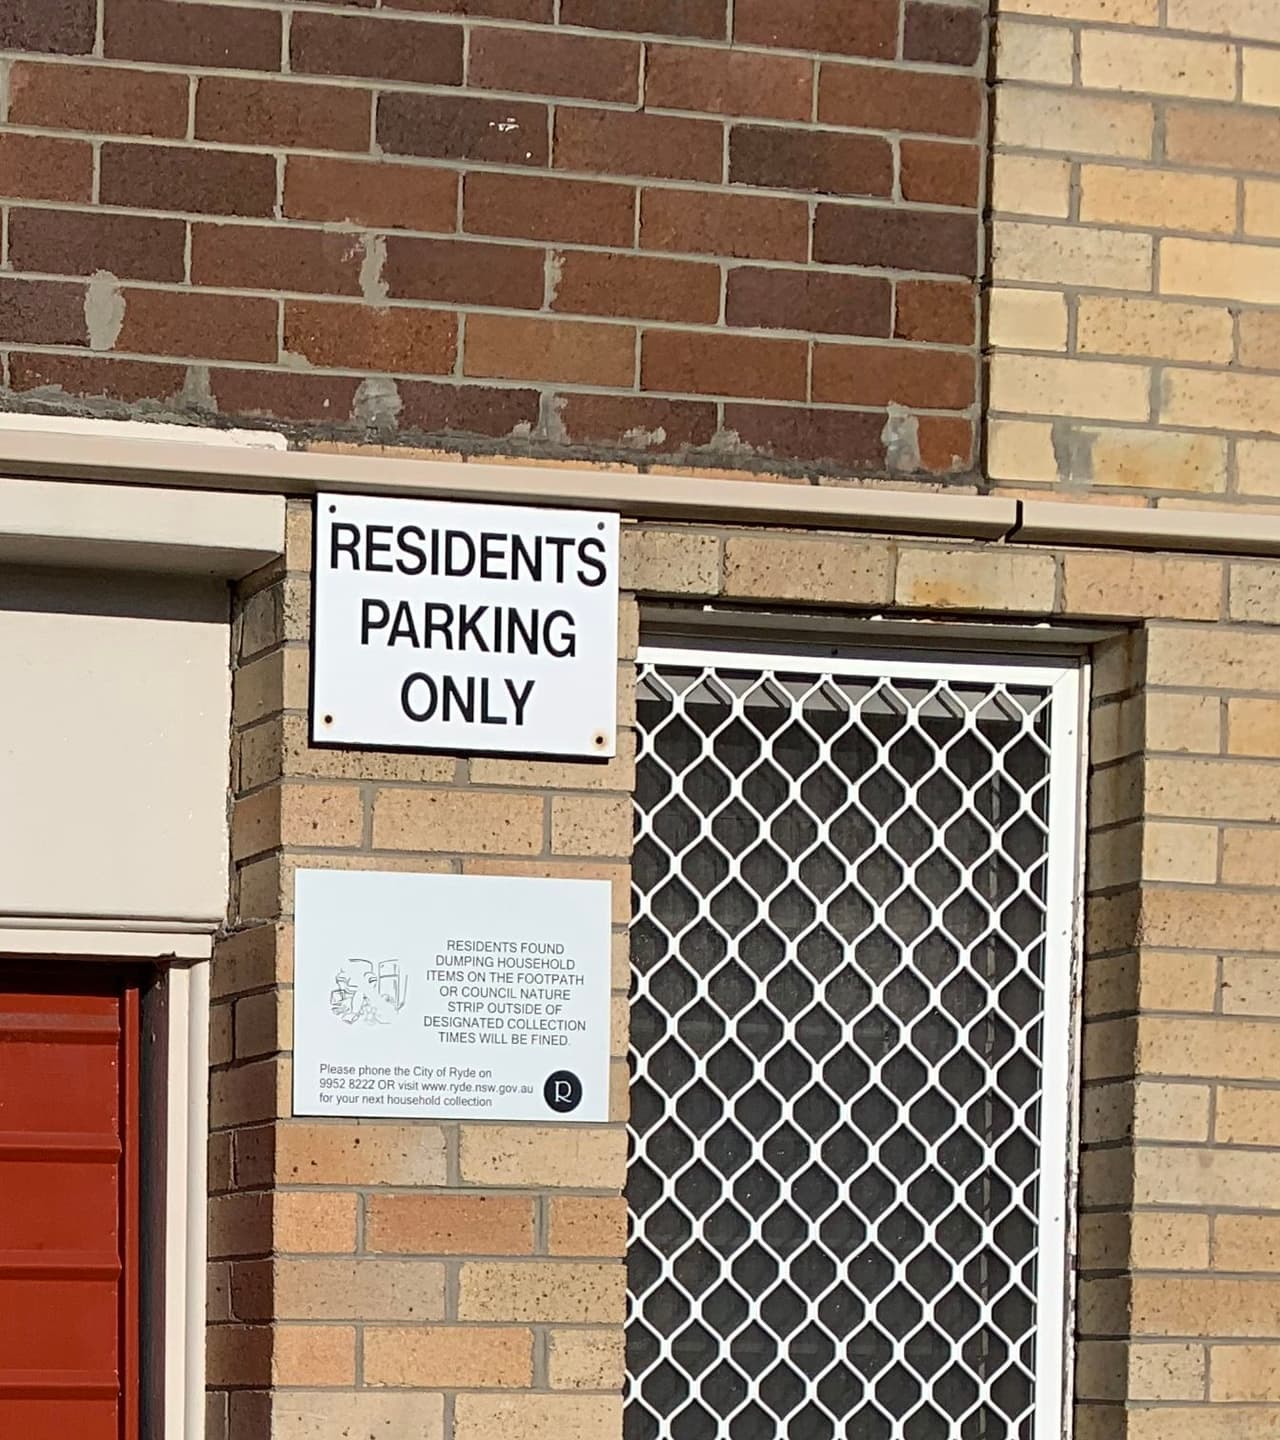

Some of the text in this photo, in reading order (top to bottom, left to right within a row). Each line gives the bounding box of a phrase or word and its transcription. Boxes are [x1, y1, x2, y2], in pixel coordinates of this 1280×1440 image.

[330, 522, 607, 587] RESIDENTS
[360, 598, 577, 658] PARKING
[400, 672, 536, 726] ONLY
[447, 940, 564, 954] RESIDENTS FOUND
[436, 955, 575, 970] DUMPING HOUSEHOLD
[426, 970, 584, 985] ITEMS ON THE FOOTPATH
[440, 986, 571, 1000] OR COUNCIL NATURE
[448, 1002, 563, 1015] STRIP OUTSIDE OF
[424, 1016, 586, 1030] DESIGNATED COLLECTION
[438, 1032, 476, 1043] TIMES
[479, 1033, 508, 1044] WILL
[512, 1034, 527, 1044] BE
[320, 1064, 492, 1080] Please phone the City of Ryde on
[320, 1079, 533, 1095] 9952 8222 OR visit www.ryde.nsw.gov.au
[319, 1094, 492, 1107] for your next household collection
